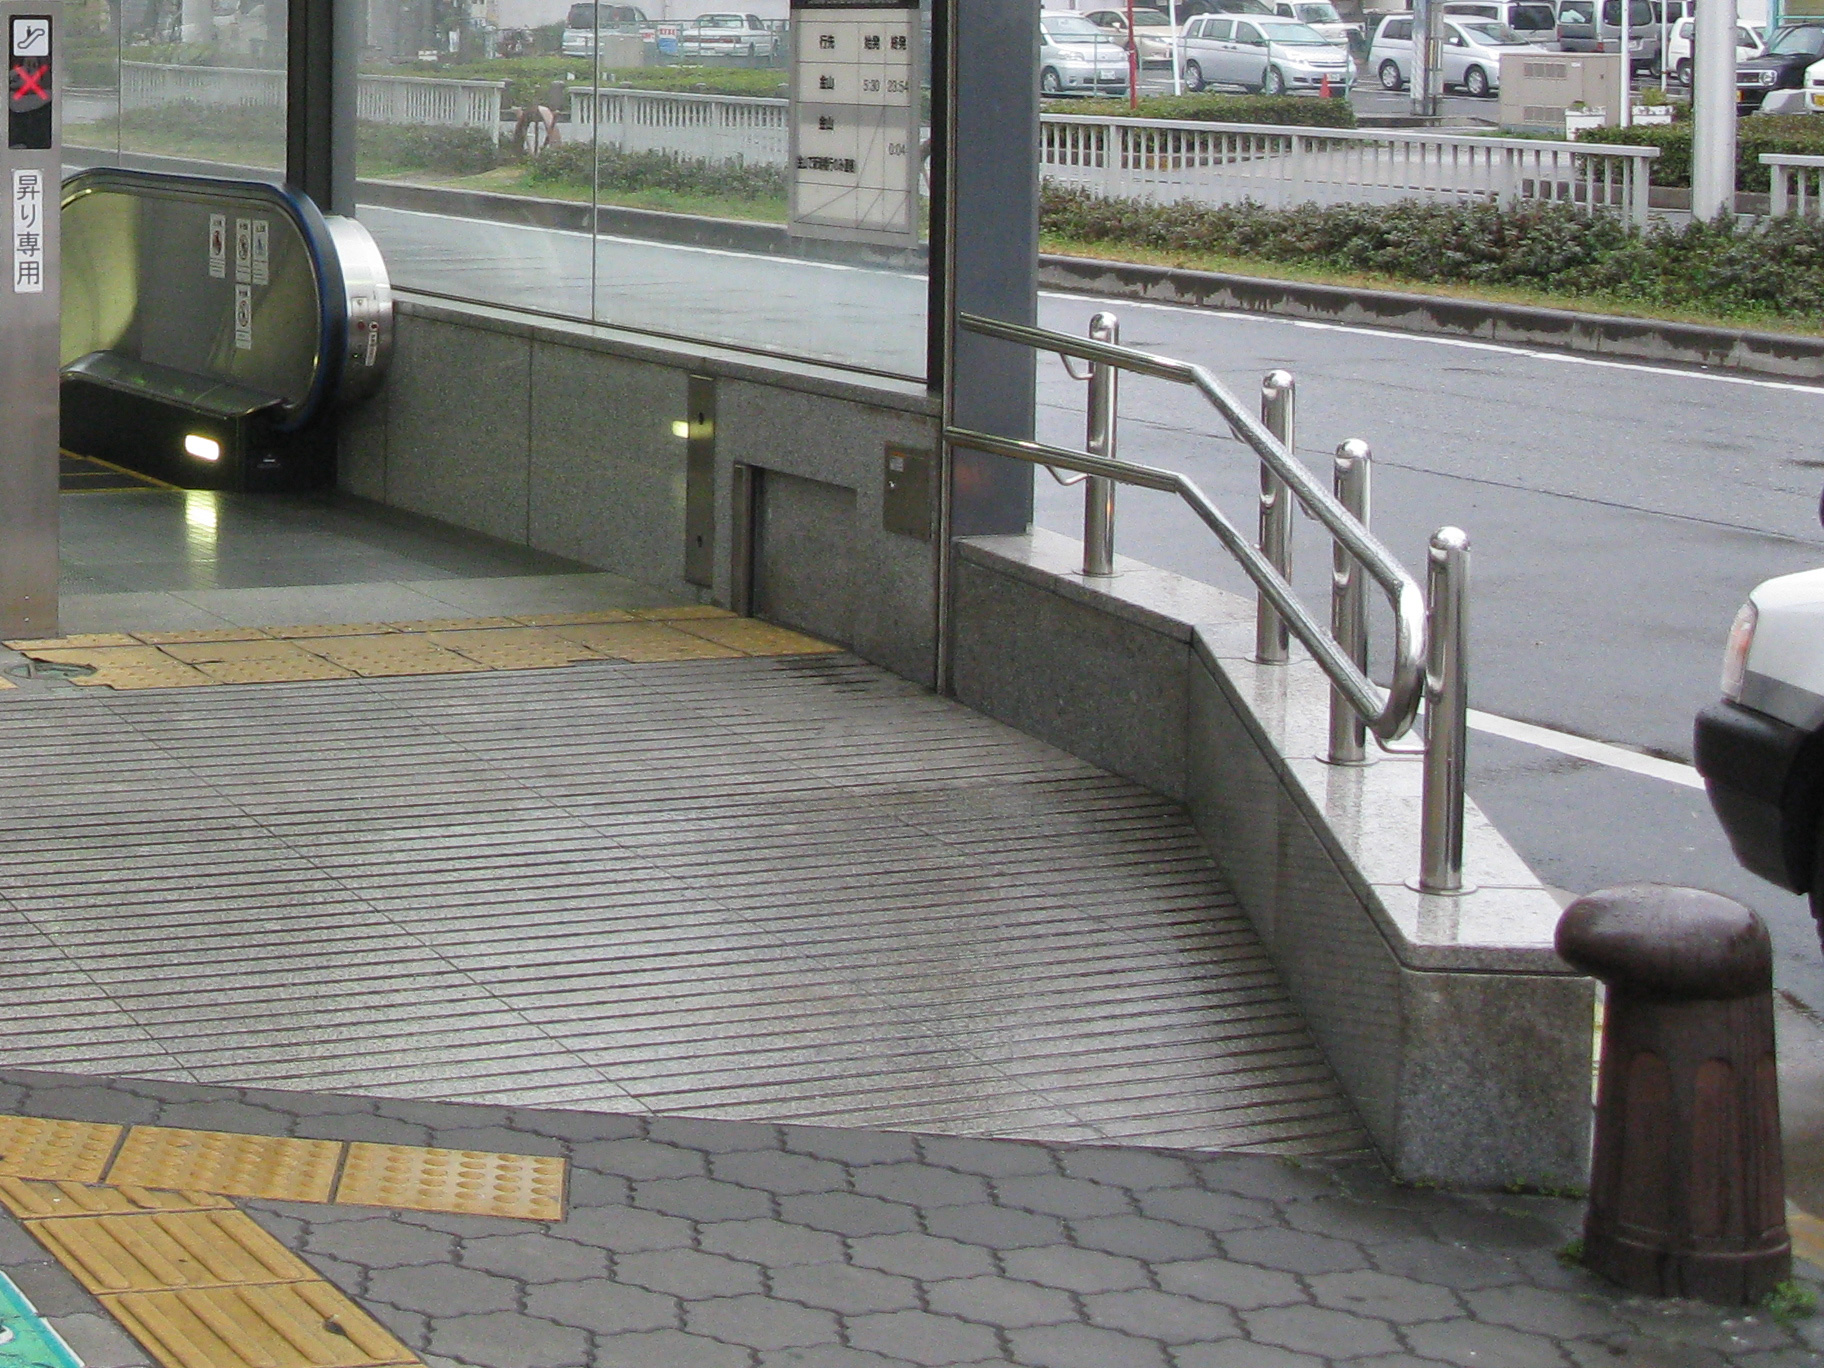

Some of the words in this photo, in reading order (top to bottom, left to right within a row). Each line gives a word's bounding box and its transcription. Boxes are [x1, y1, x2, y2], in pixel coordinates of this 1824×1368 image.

[887, 79, 909, 93] 23:54
[16, 174, 41, 286] 昇り専用
